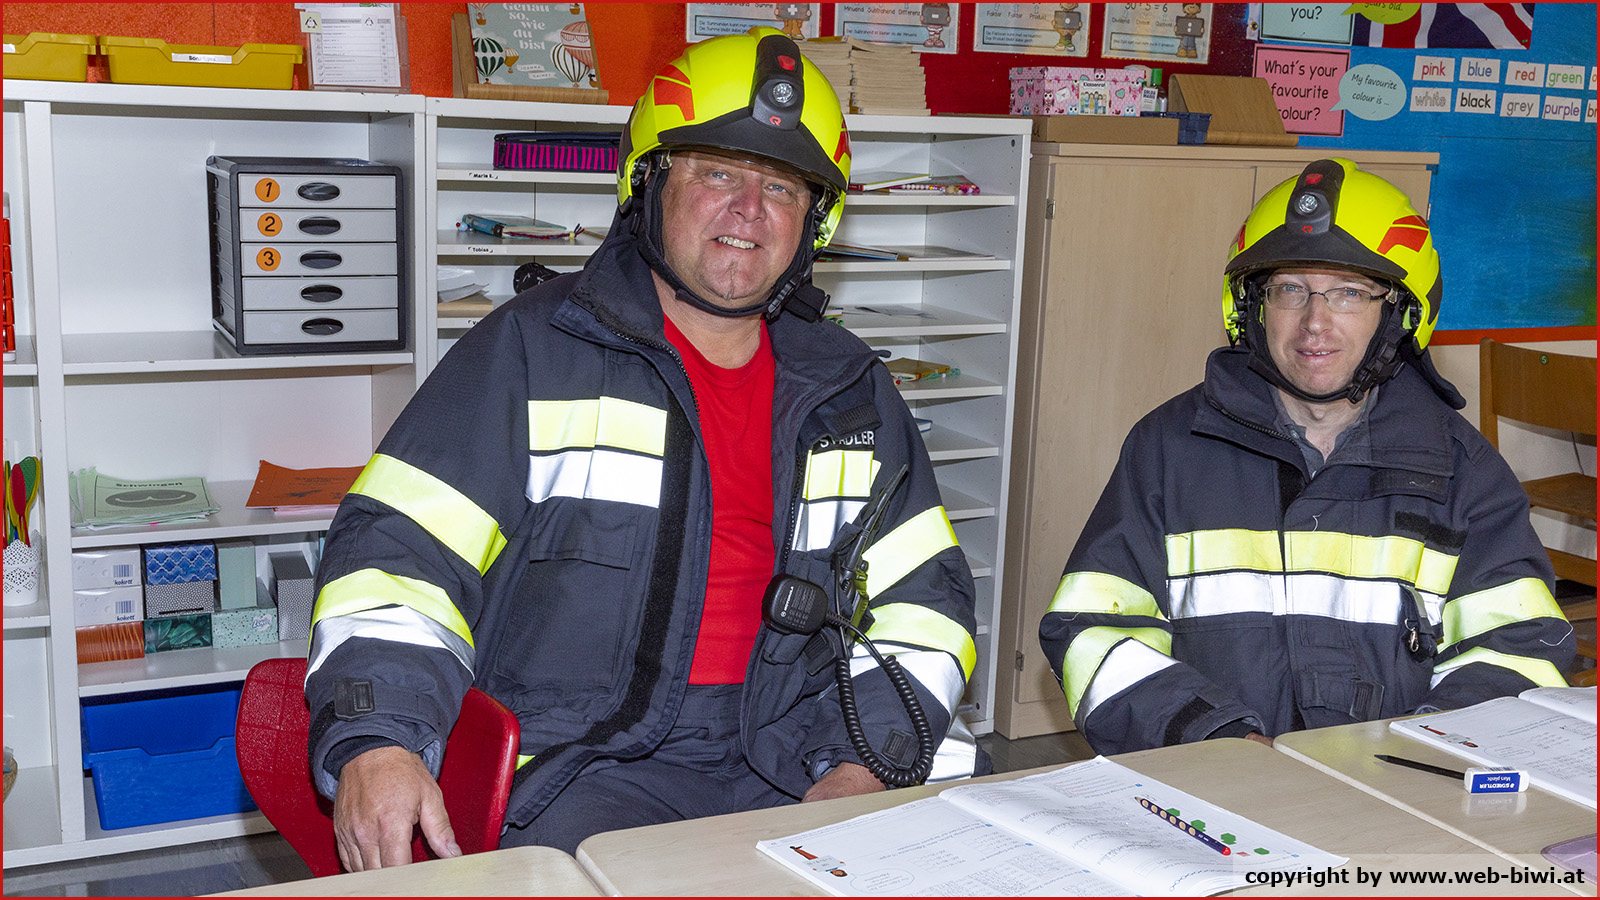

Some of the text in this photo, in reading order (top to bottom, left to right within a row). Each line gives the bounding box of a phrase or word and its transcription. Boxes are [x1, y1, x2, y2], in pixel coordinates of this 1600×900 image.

[1290, 5, 1322, 22] you?
[520, 19, 546, 30] wie
[513, 29, 533, 38] du
[519, 40, 546, 50] bist
[1264, 60, 1338, 80] What's your
[1421, 61, 1446, 80] pink
[1467, 61, 1492, 77] blue
[1515, 67, 1536, 81] red
[1352, 73, 1397, 90] My favourite
[1548, 72, 1582, 87] green
[1271, 83, 1329, 99] favourite
[1352, 91, 1374, 102] colour
[1375, 95, 1382, 104] is
[1415, 91, 1446, 107] white
[1460, 92, 1491, 108] black
[1278, 107, 1321, 120] olour?
[1507, 101, 1534, 116] grey
[1543, 102, 1580, 120] purple
[266, 181, 272, 198] 1
[265, 216, 275, 232] 2
[263, 250, 274, 266] 3
[820, 430, 875, 448] SDLER
